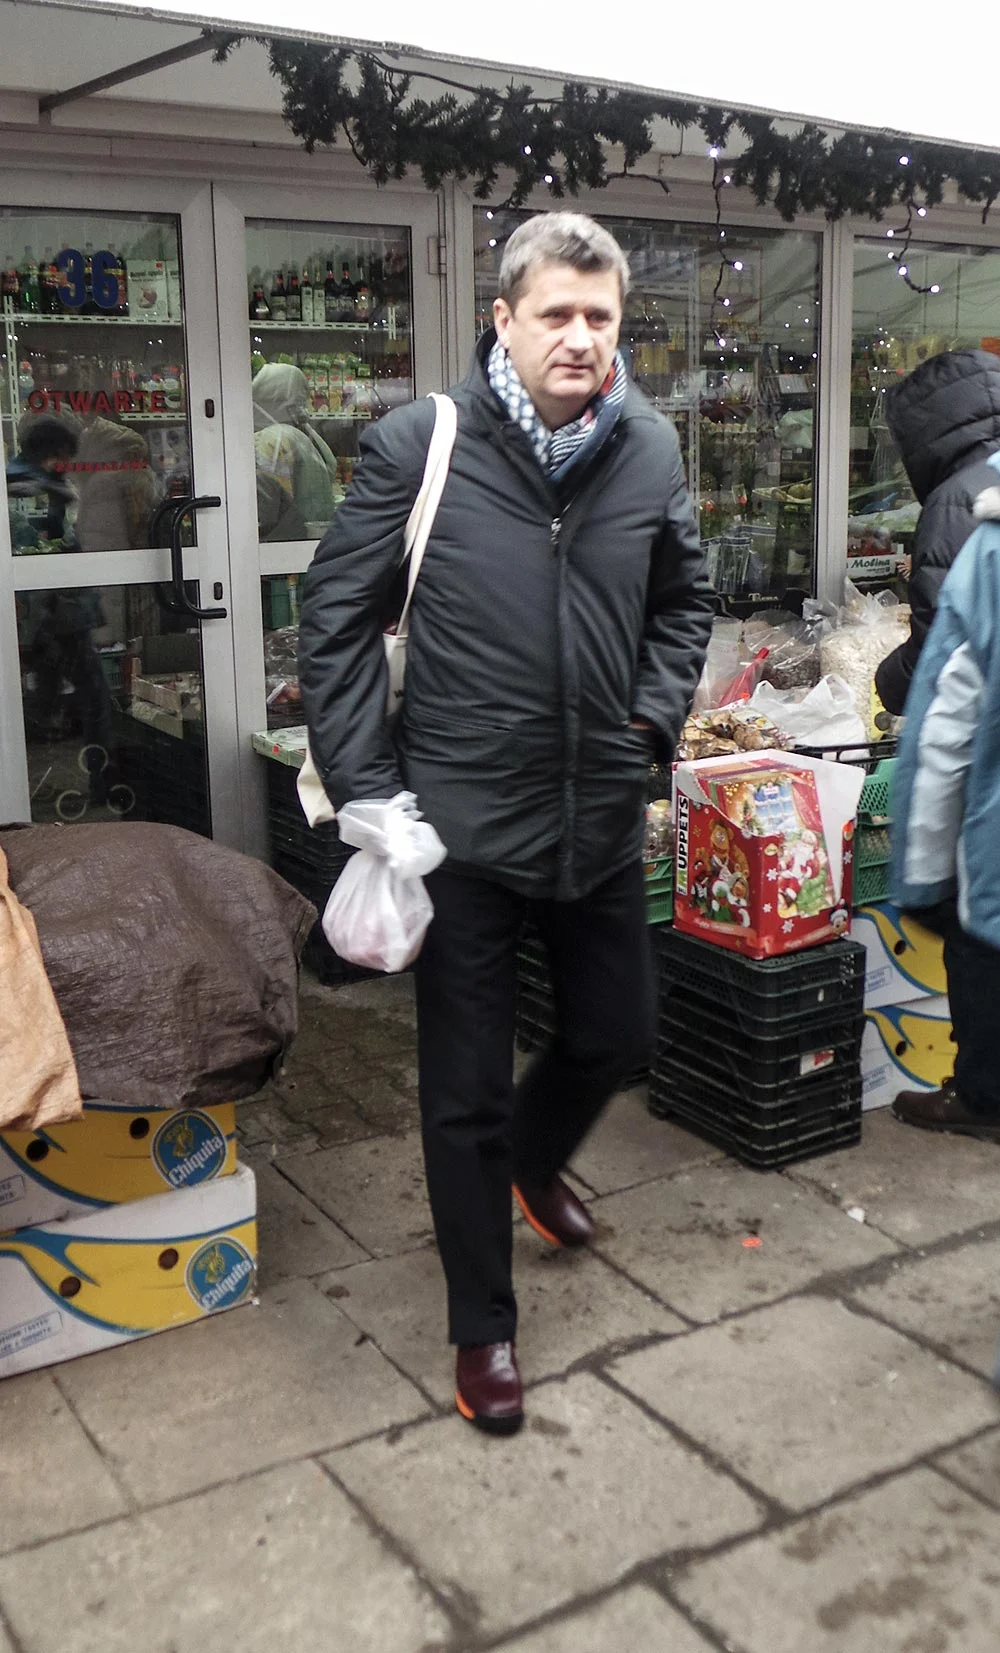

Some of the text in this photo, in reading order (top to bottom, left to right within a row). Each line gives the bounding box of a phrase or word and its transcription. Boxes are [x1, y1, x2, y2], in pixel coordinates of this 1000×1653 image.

[57, 249, 120, 308] 36
[28, 391, 166, 413] OTWARTE
[851, 558, 891, 569] Molina
[168, 1135, 224, 1187] Chiquita
[201, 1259, 252, 1310] Chiquita
